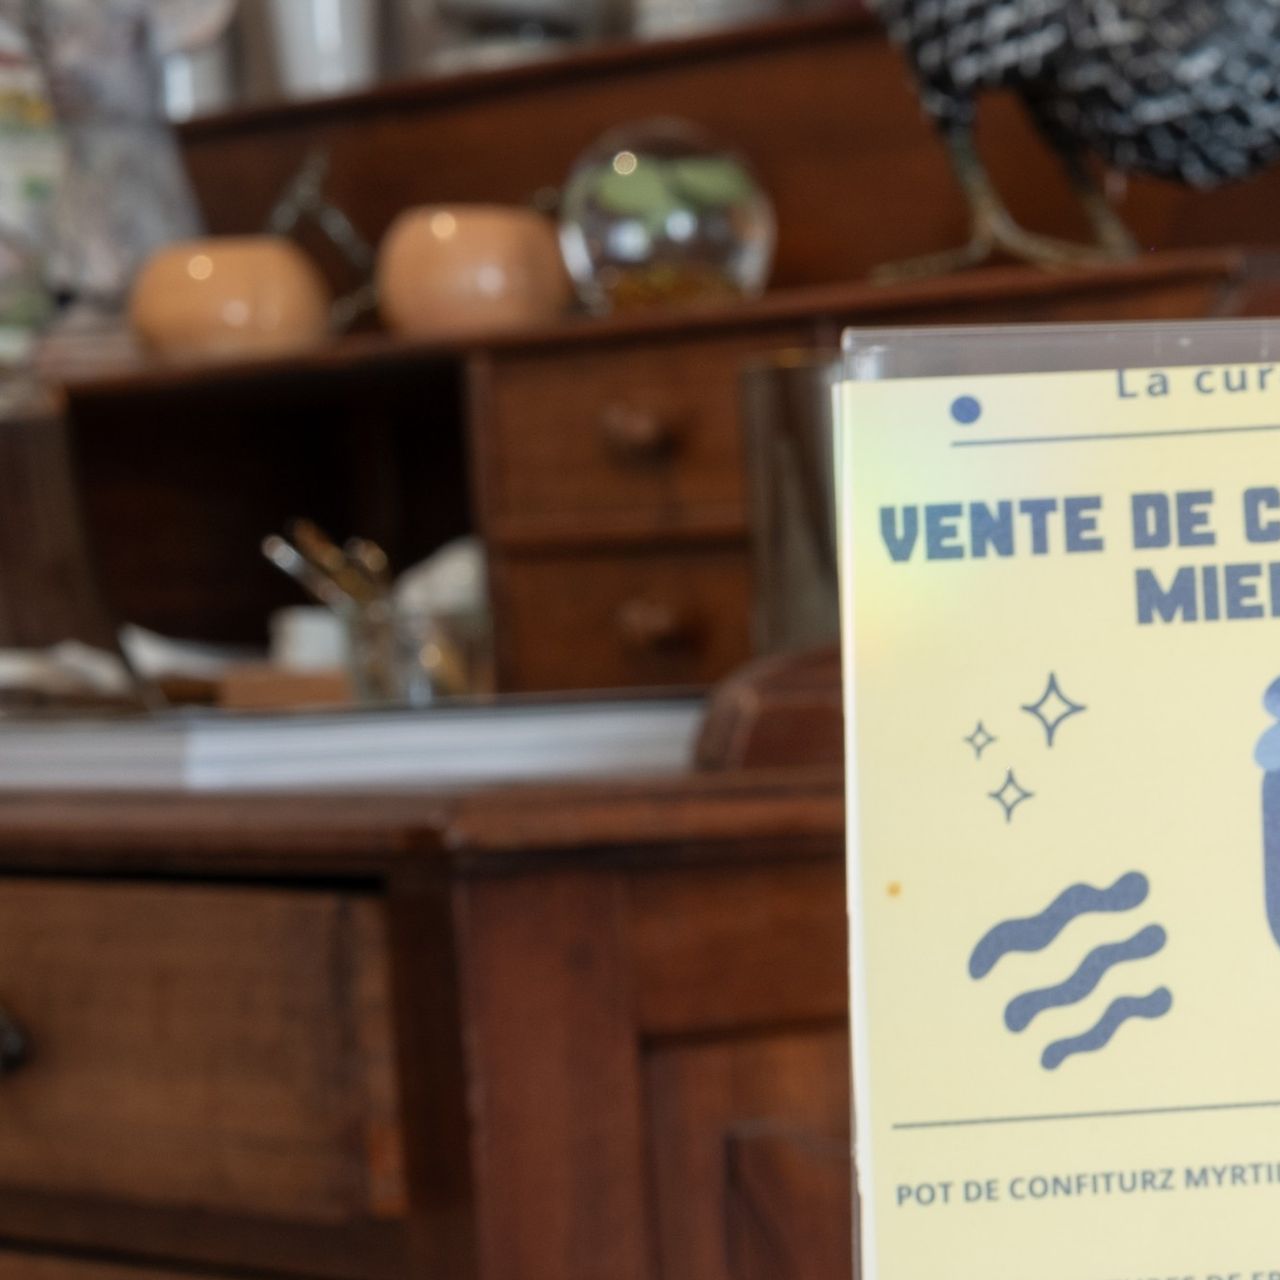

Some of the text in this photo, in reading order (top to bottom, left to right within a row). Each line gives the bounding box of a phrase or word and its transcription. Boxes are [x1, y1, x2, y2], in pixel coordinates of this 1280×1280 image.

[1117, 367, 1169, 398] La
[879, 495, 1104, 563] VENTE
[1130, 489, 1216, 550] DE
[896, 1181, 953, 1206] POT
[963, 1178, 999, 1203] DE
[1009, 1167, 1175, 1200] CONFITURZ
